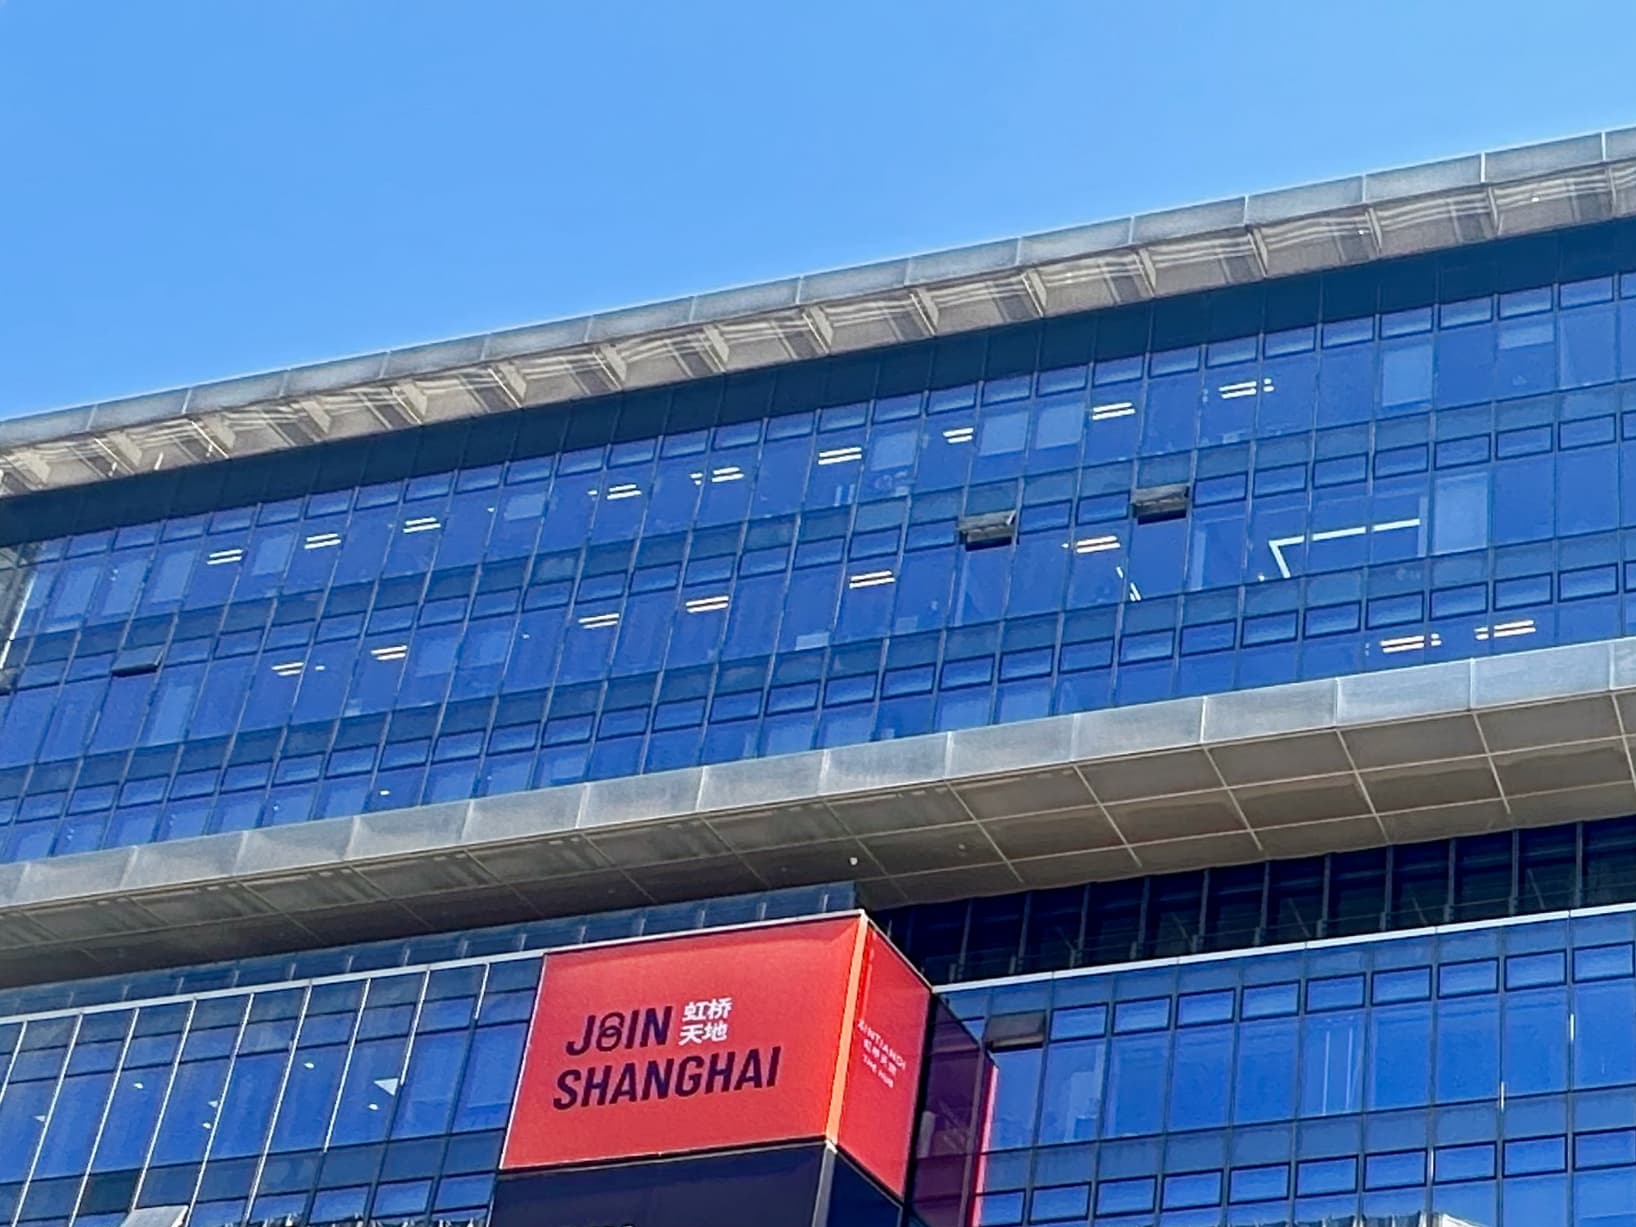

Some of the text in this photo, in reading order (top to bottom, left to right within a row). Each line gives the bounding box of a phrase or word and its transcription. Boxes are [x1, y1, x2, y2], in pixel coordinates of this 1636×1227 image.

[683, 997, 732, 1021] 虹桥
[566, 1006, 673, 1056] JOIN
[679, 1022, 728, 1046] 天地
[552, 1047, 782, 1110] SHANGHAI
